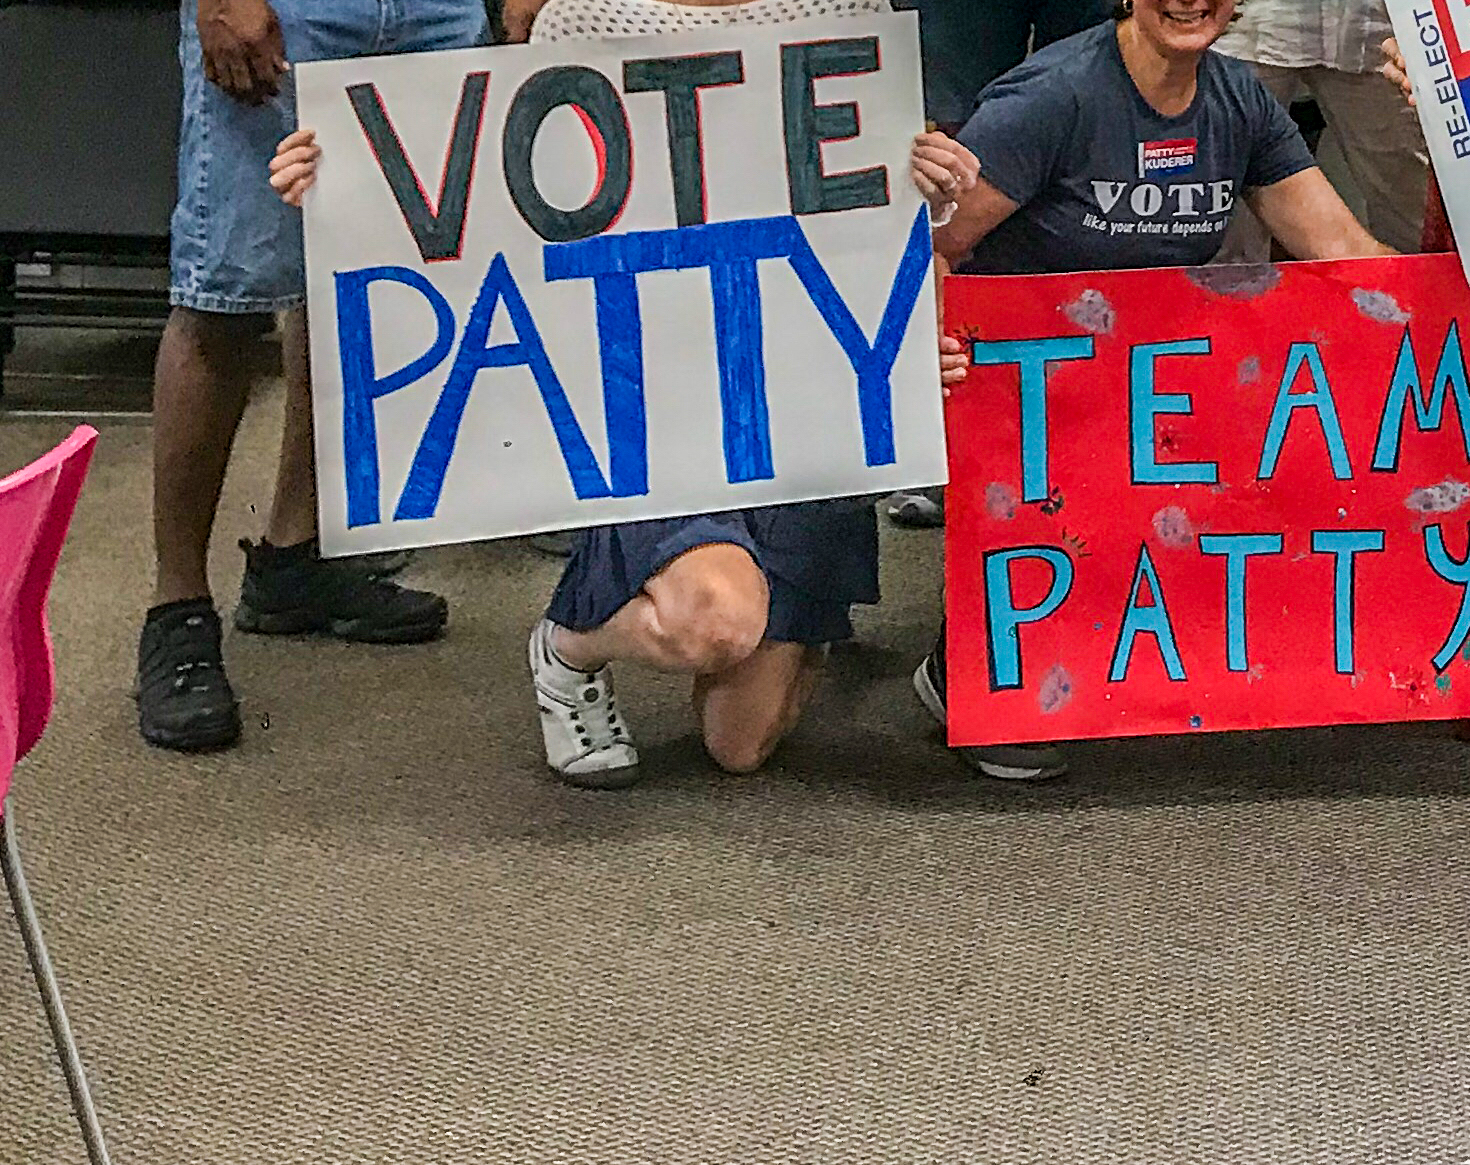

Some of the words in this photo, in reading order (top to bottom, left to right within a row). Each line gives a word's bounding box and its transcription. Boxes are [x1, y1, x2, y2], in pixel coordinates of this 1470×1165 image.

[345, 36, 890, 264] VOTE
[1144, 147, 1175, 158] PATTY
[1144, 154, 1194, 170] KUDERER
[1090, 179, 1234, 217] VOTE
[1082, 212, 1107, 231] like
[1110, 221, 1135, 235] your
[1137, 220, 1169, 234] future
[1172, 219, 1213, 237] depends
[333, 203, 933, 530] PATTY
